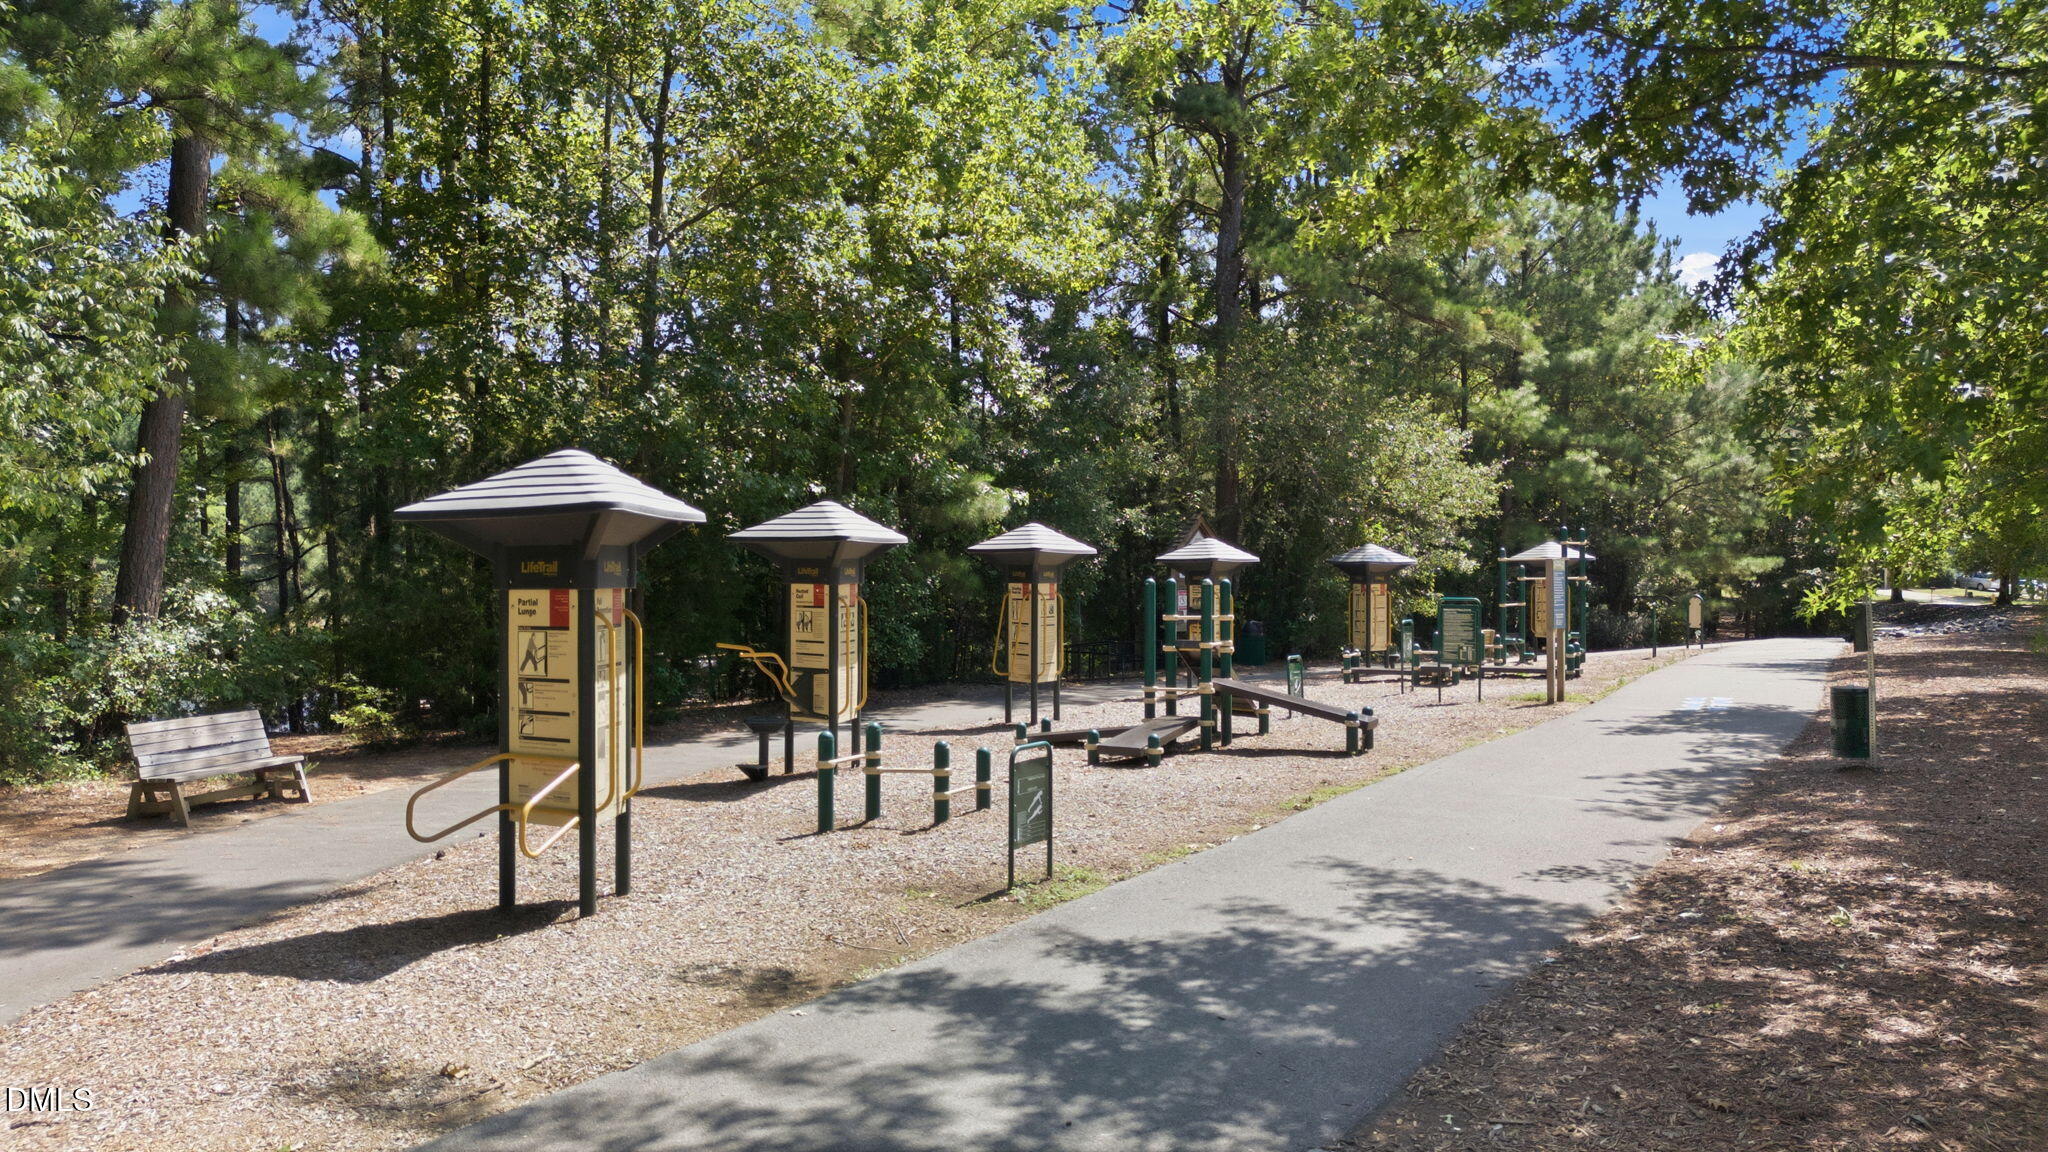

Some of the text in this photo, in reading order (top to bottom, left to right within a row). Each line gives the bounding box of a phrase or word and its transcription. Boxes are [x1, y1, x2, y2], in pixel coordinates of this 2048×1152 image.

[521, 561, 558, 573] LifeTrail
[518, 598, 538, 606] Partial
[518, 608, 537, 617] Lunge
